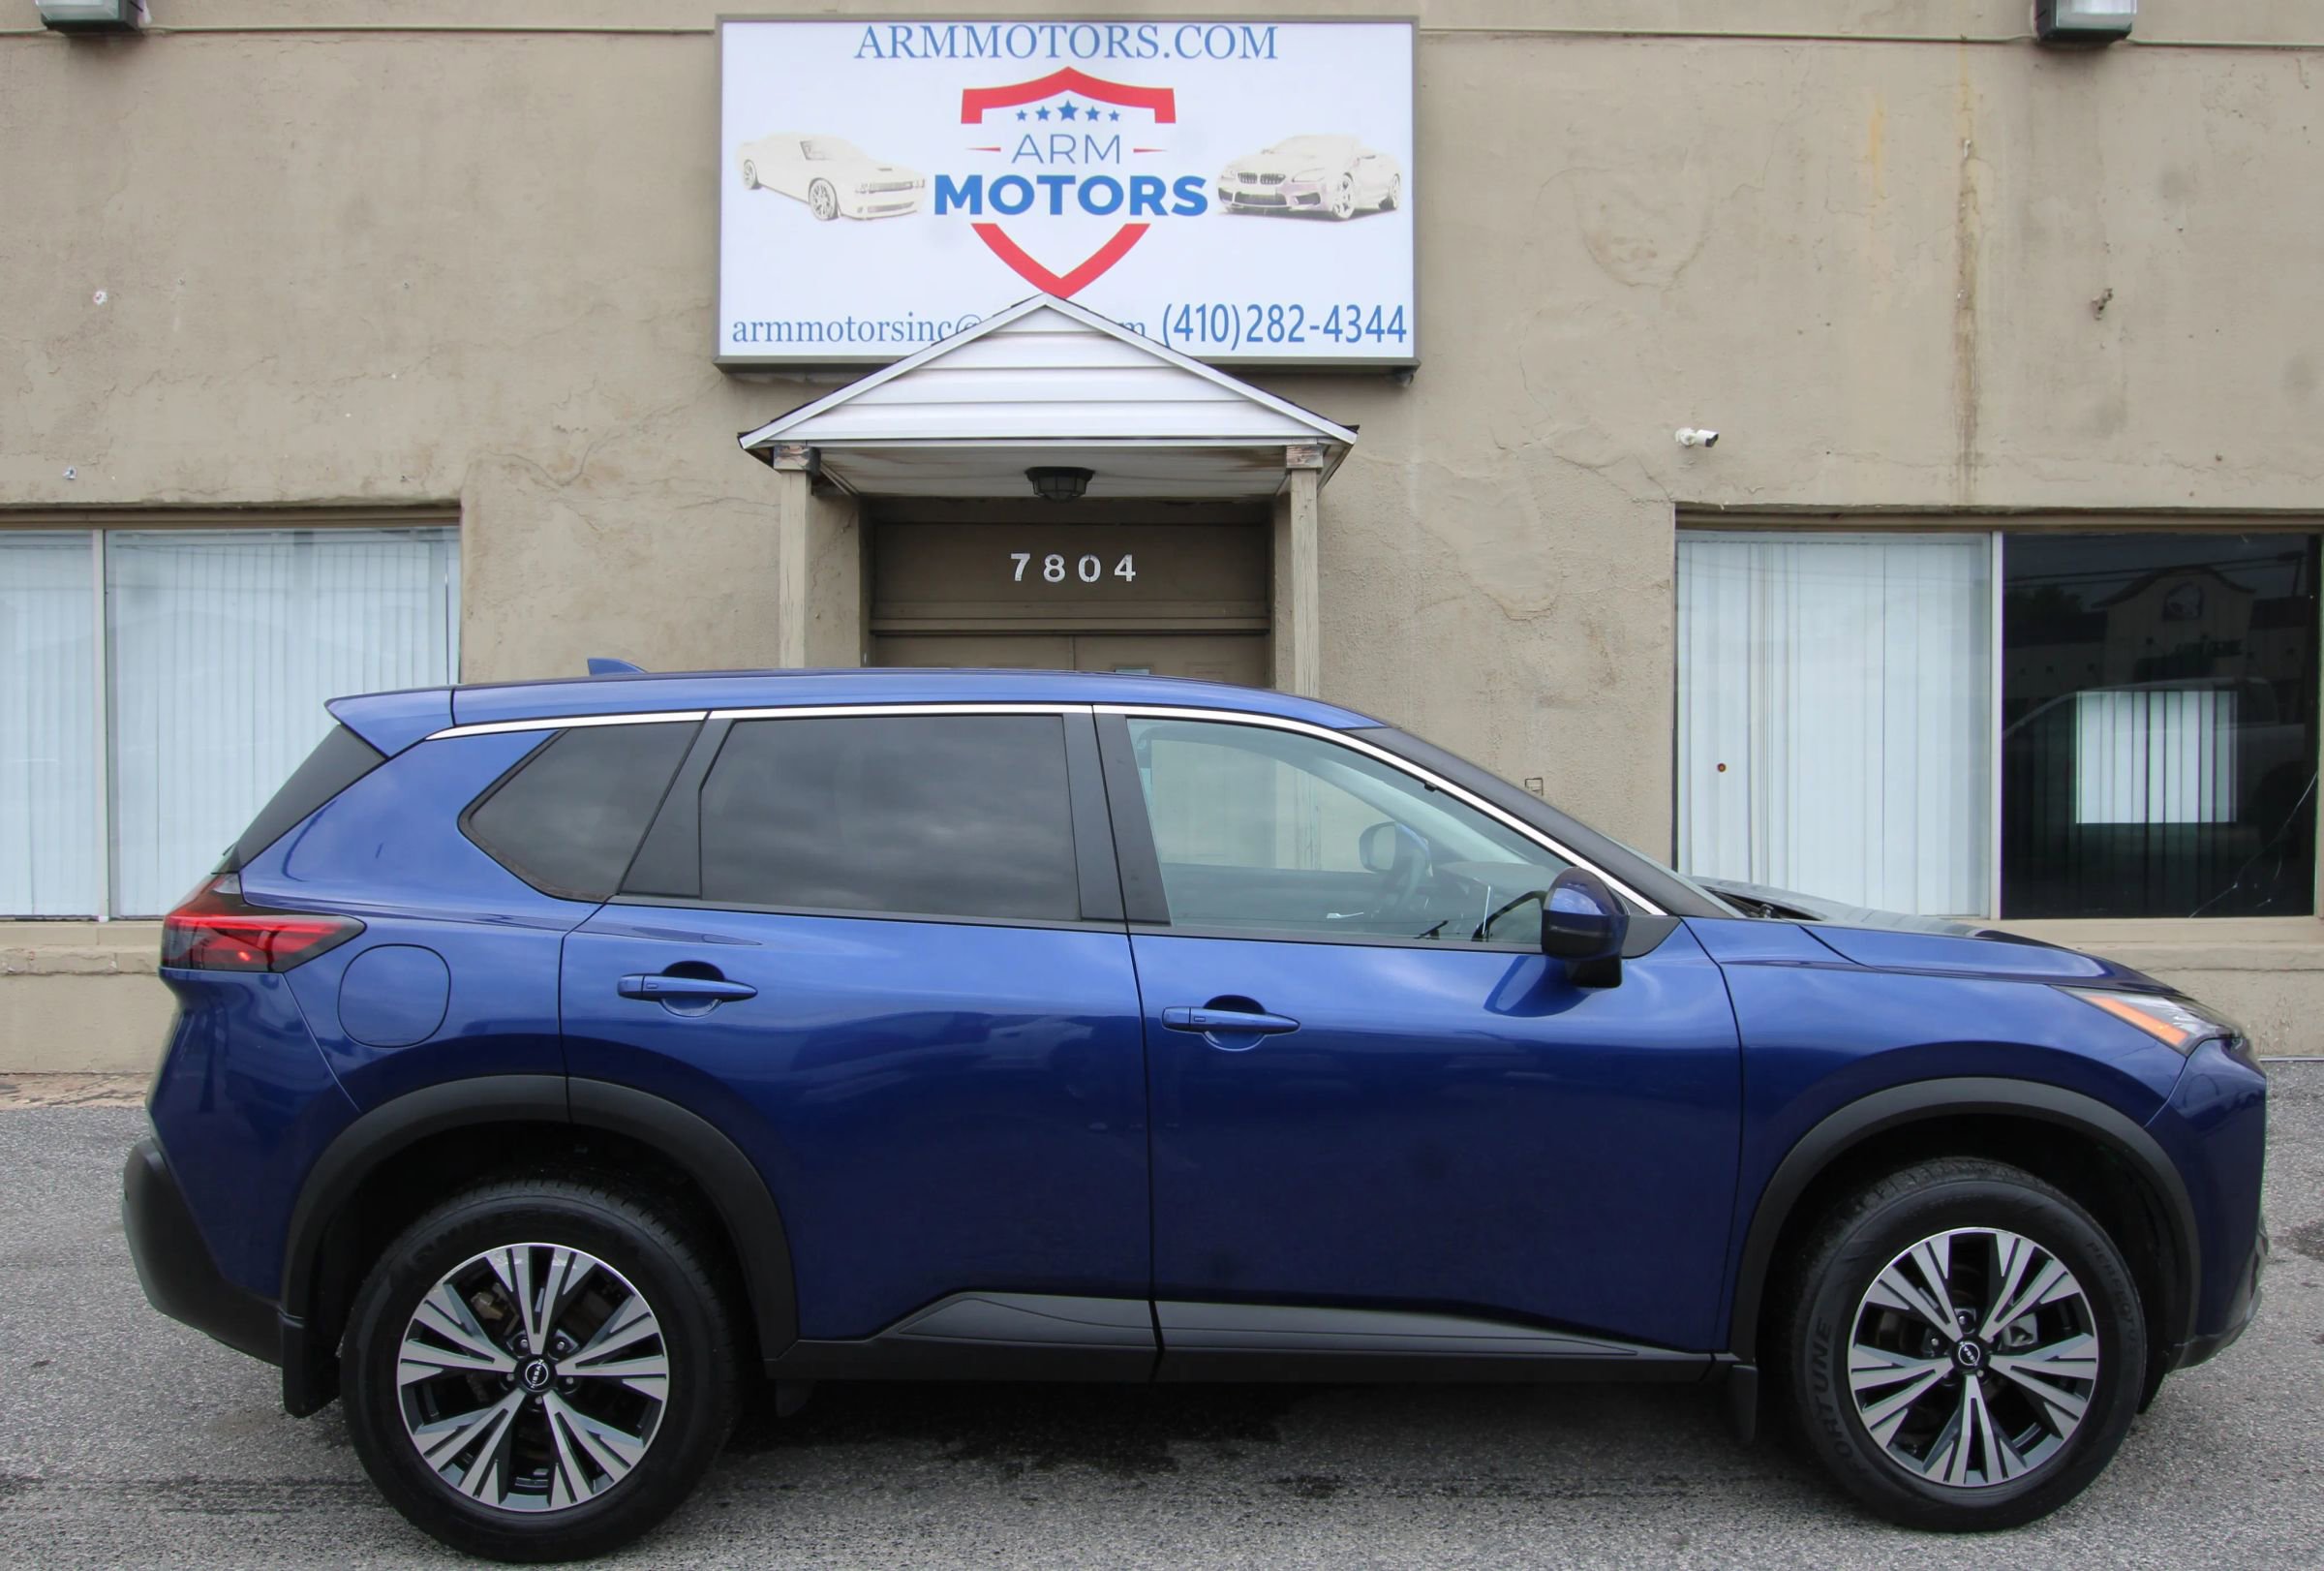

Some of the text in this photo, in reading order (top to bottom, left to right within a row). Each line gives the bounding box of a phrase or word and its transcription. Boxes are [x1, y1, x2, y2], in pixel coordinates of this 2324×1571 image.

[854, 23, 1278, 60] ARMMOTORS.COM
[1012, 134, 1121, 164] ARM
[934, 174, 1208, 217] MOTORS
[1162, 303, 1407, 350] (410)282-4344
[1010, 552, 1137, 583] 7804
